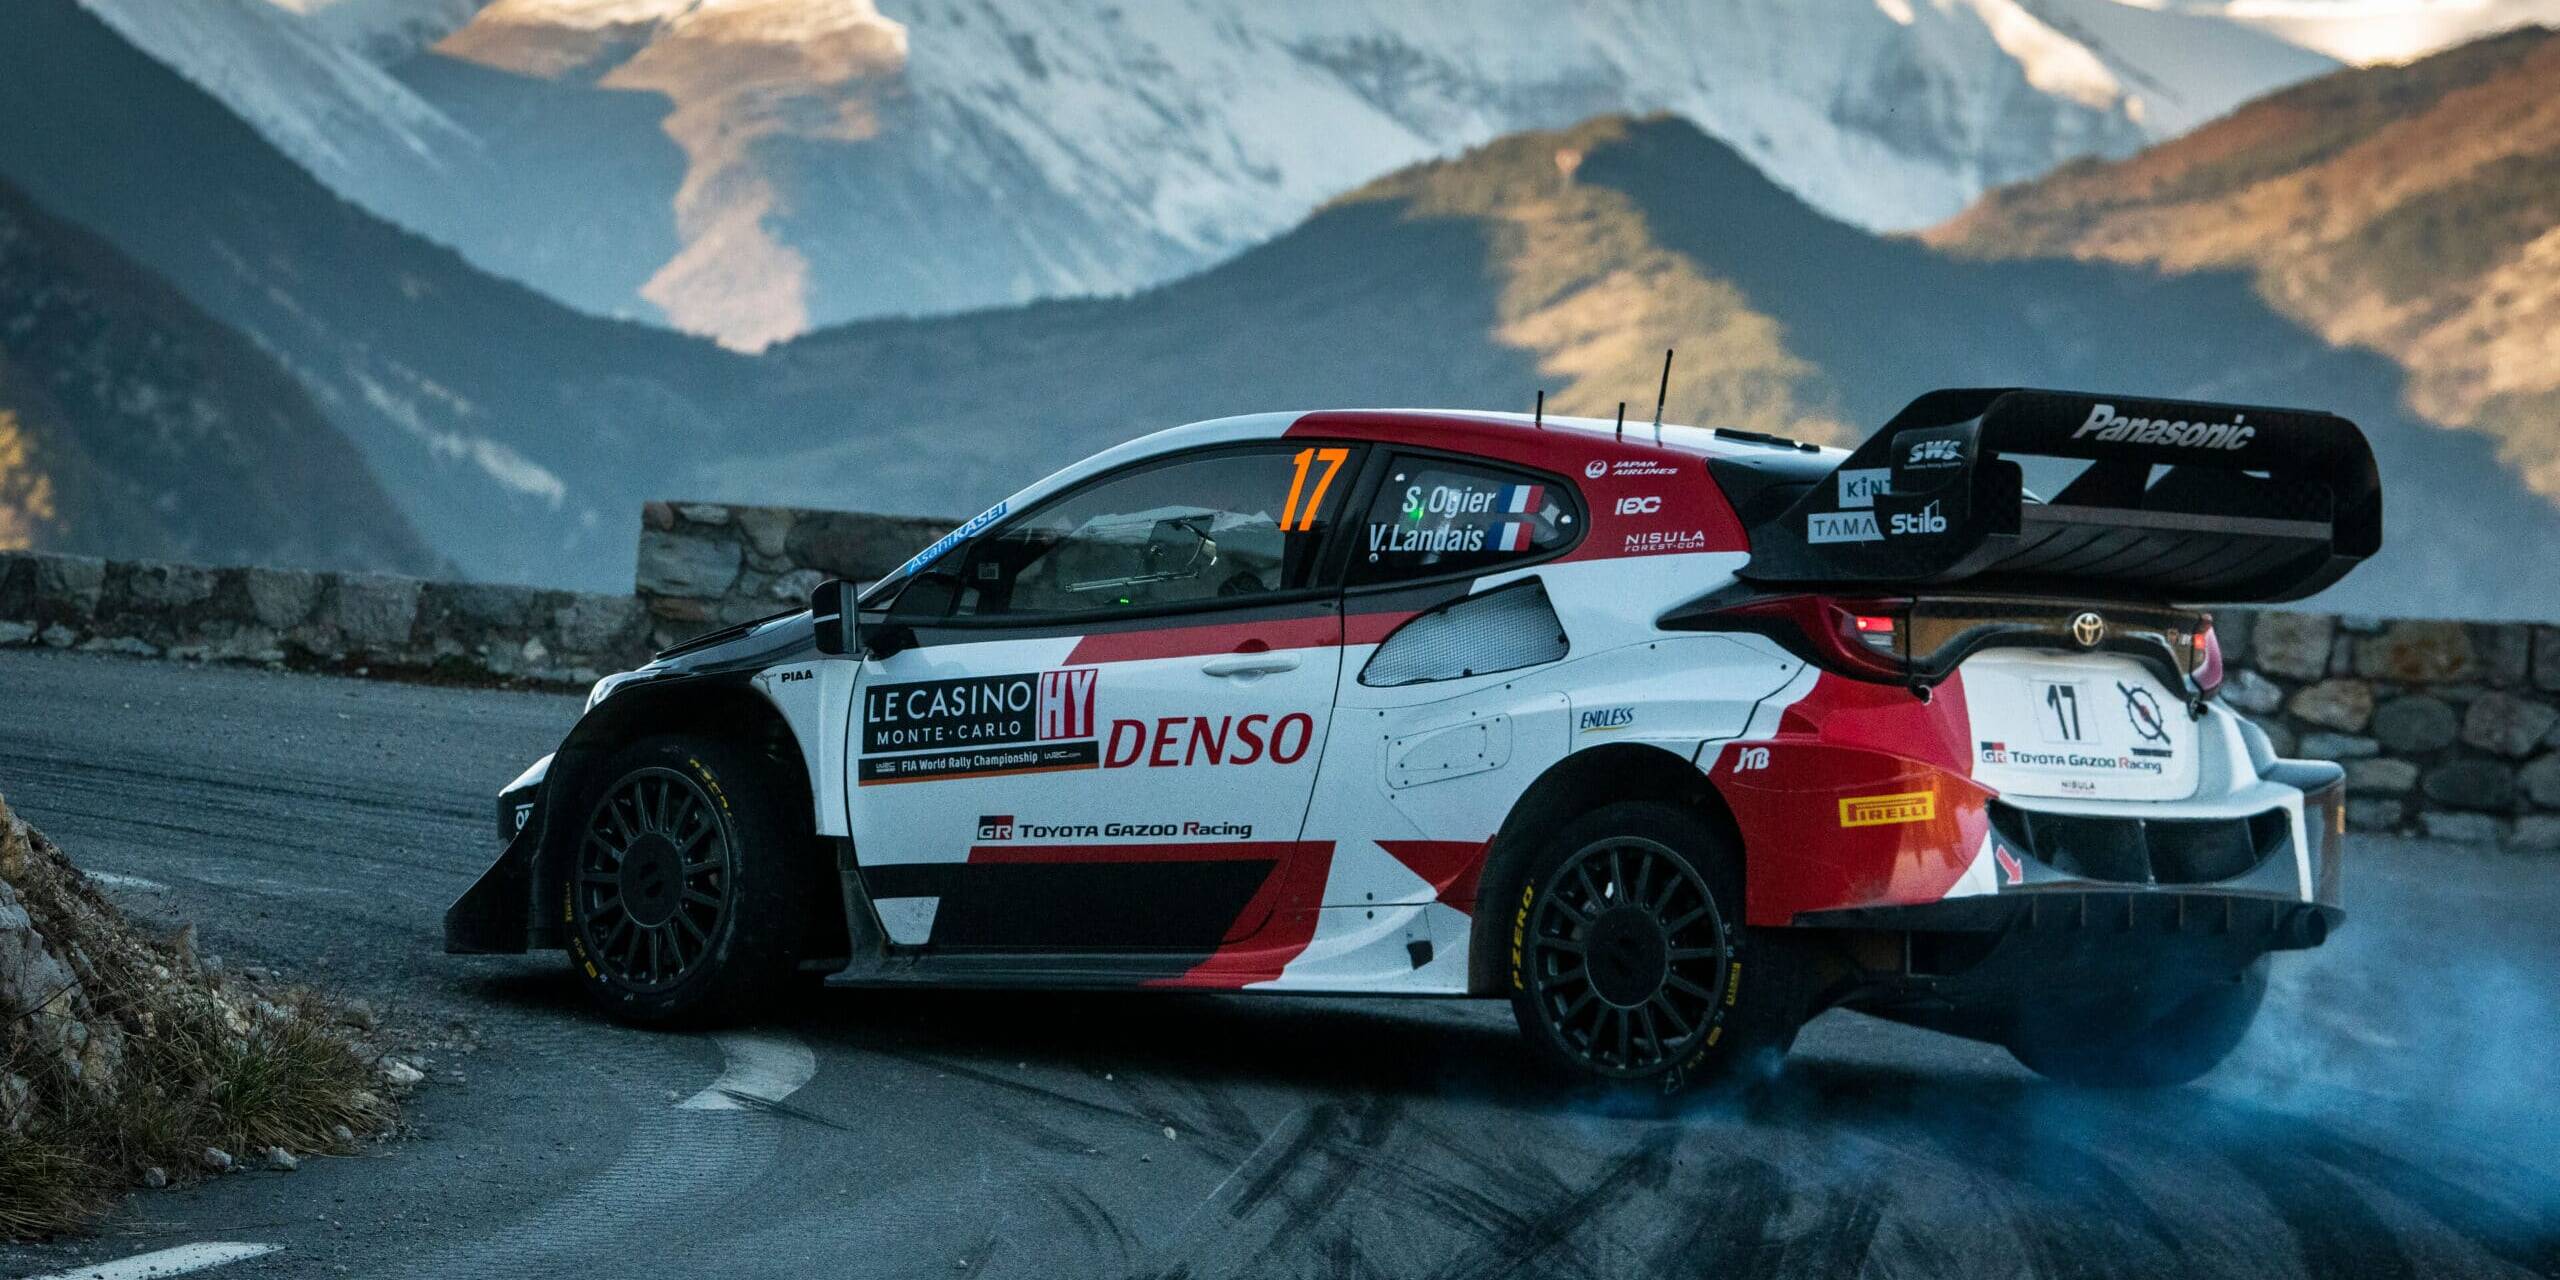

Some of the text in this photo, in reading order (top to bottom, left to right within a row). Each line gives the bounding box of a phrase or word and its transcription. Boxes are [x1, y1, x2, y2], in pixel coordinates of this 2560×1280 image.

[2072, 403, 2256, 450] Panasonic
[1908, 440, 1963, 463] SWS
[1612, 460, 1658, 469] JAPAN
[1612, 468, 1678, 476] AIRLINES
[1279, 448, 1349, 531] 17
[1890, 500, 1947, 534] Stilo
[1625, 530, 1705, 545] NISULA
[781, 669, 814, 683] PIAA
[869, 681, 1032, 723] LE CASINO
[1041, 669, 1097, 740] HY
[2047, 684, 2081, 740] 17
[1580, 707, 1635, 729] ENDLESS
[1104, 711, 1314, 769] DENSO
[902, 759, 918, 772] FIA
[919, 757, 946, 770] World
[949, 755, 972, 770] Rally
[974, 750, 1038, 767] Championship
[1733, 747, 1770, 773] JTB
[1982, 749, 2162, 774] GR TOYOTA GAZOO Racing
[1847, 797, 1929, 822] PIRELLI
[978, 821, 1253, 840] GR TOYOTA GAZOO Racing
